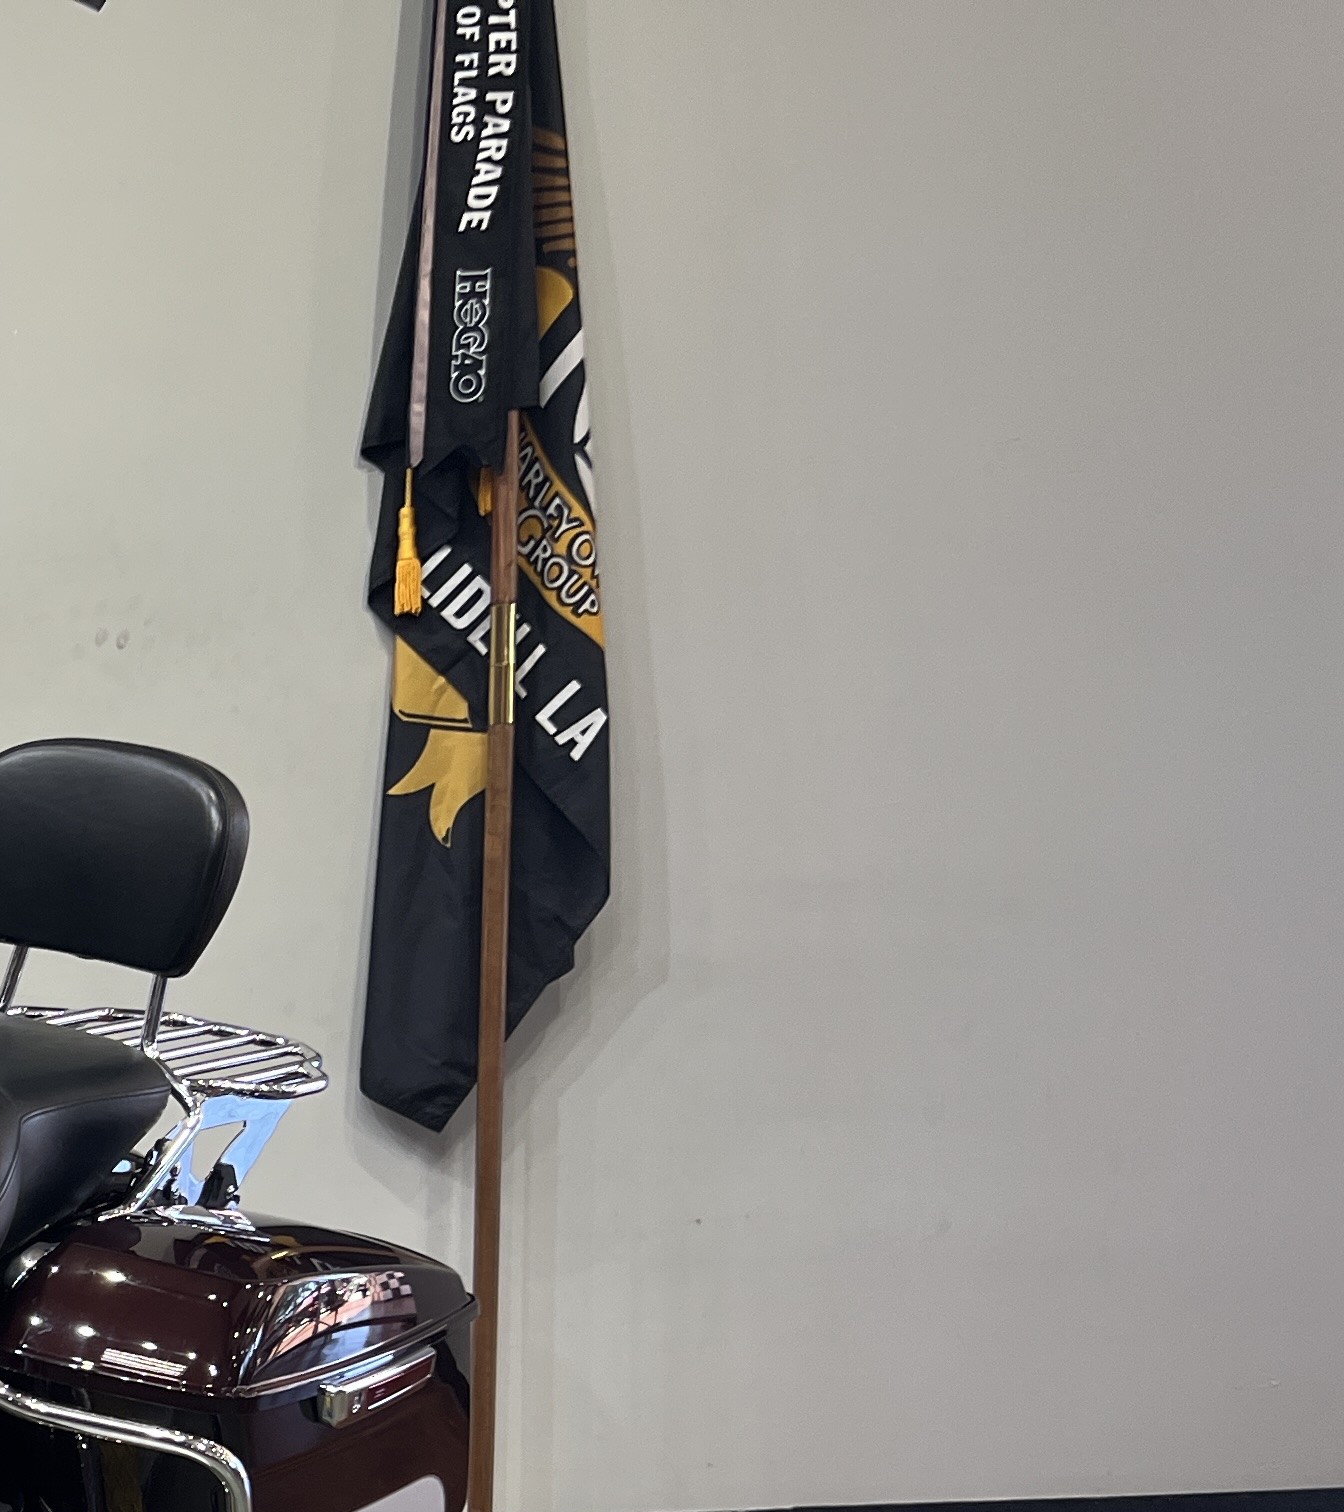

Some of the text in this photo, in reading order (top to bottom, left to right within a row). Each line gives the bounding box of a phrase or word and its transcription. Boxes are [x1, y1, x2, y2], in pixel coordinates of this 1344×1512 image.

[449, 5, 482, 144] OF FLAGS
[457, 90, 515, 233] PARADE
[518, 432, 581, 538] ARLEY
[517, 508, 600, 616] GROUP
[534, 679, 608, 762] LA
